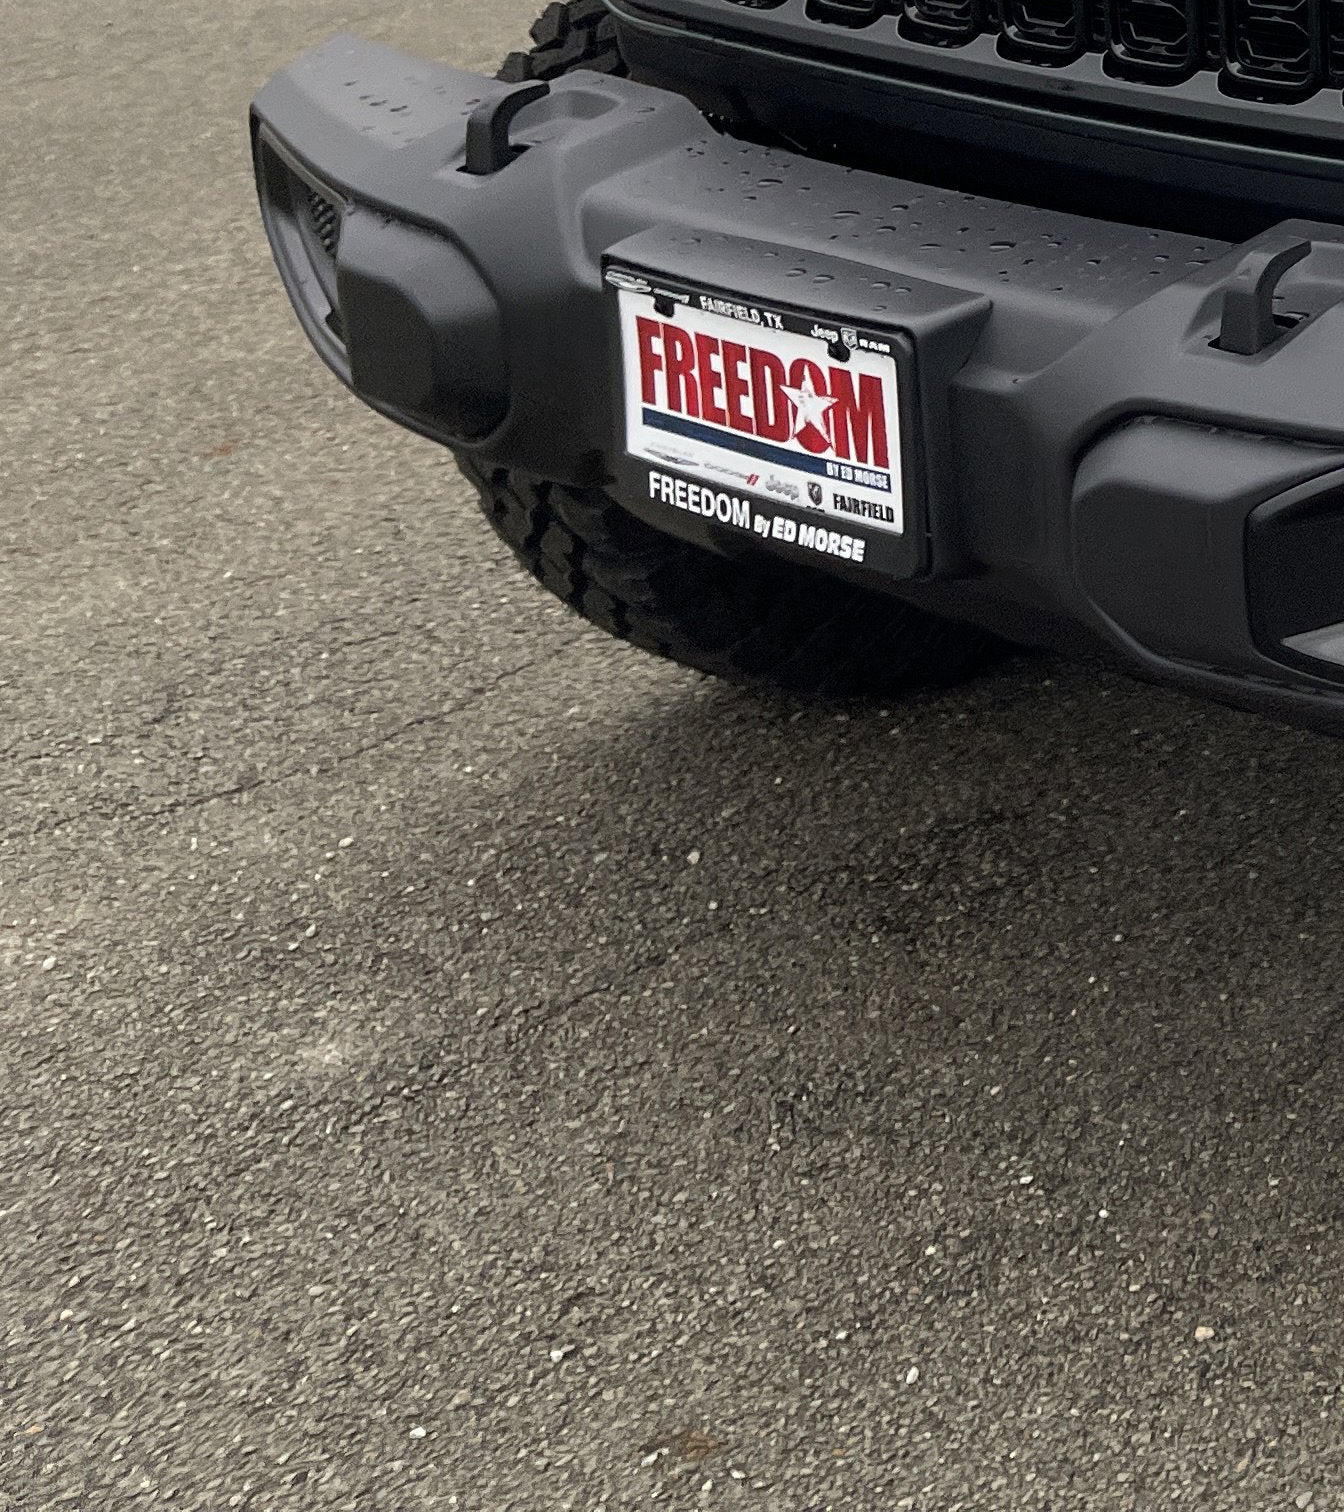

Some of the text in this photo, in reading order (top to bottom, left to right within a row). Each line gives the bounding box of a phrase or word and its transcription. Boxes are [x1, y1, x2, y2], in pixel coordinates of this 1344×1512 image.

[764, 311, 784, 331] TX
[811, 324, 890, 353] Jeep RAM
[636, 316, 889, 468] FREEDOM
[826, 461, 889, 489] BY ED MORSE
[648, 470, 751, 529] FREEDOM
[772, 517, 796, 542] ED
[798, 523, 866, 563] MORSE
[833, 494, 894, 523] FAIRFIELD
